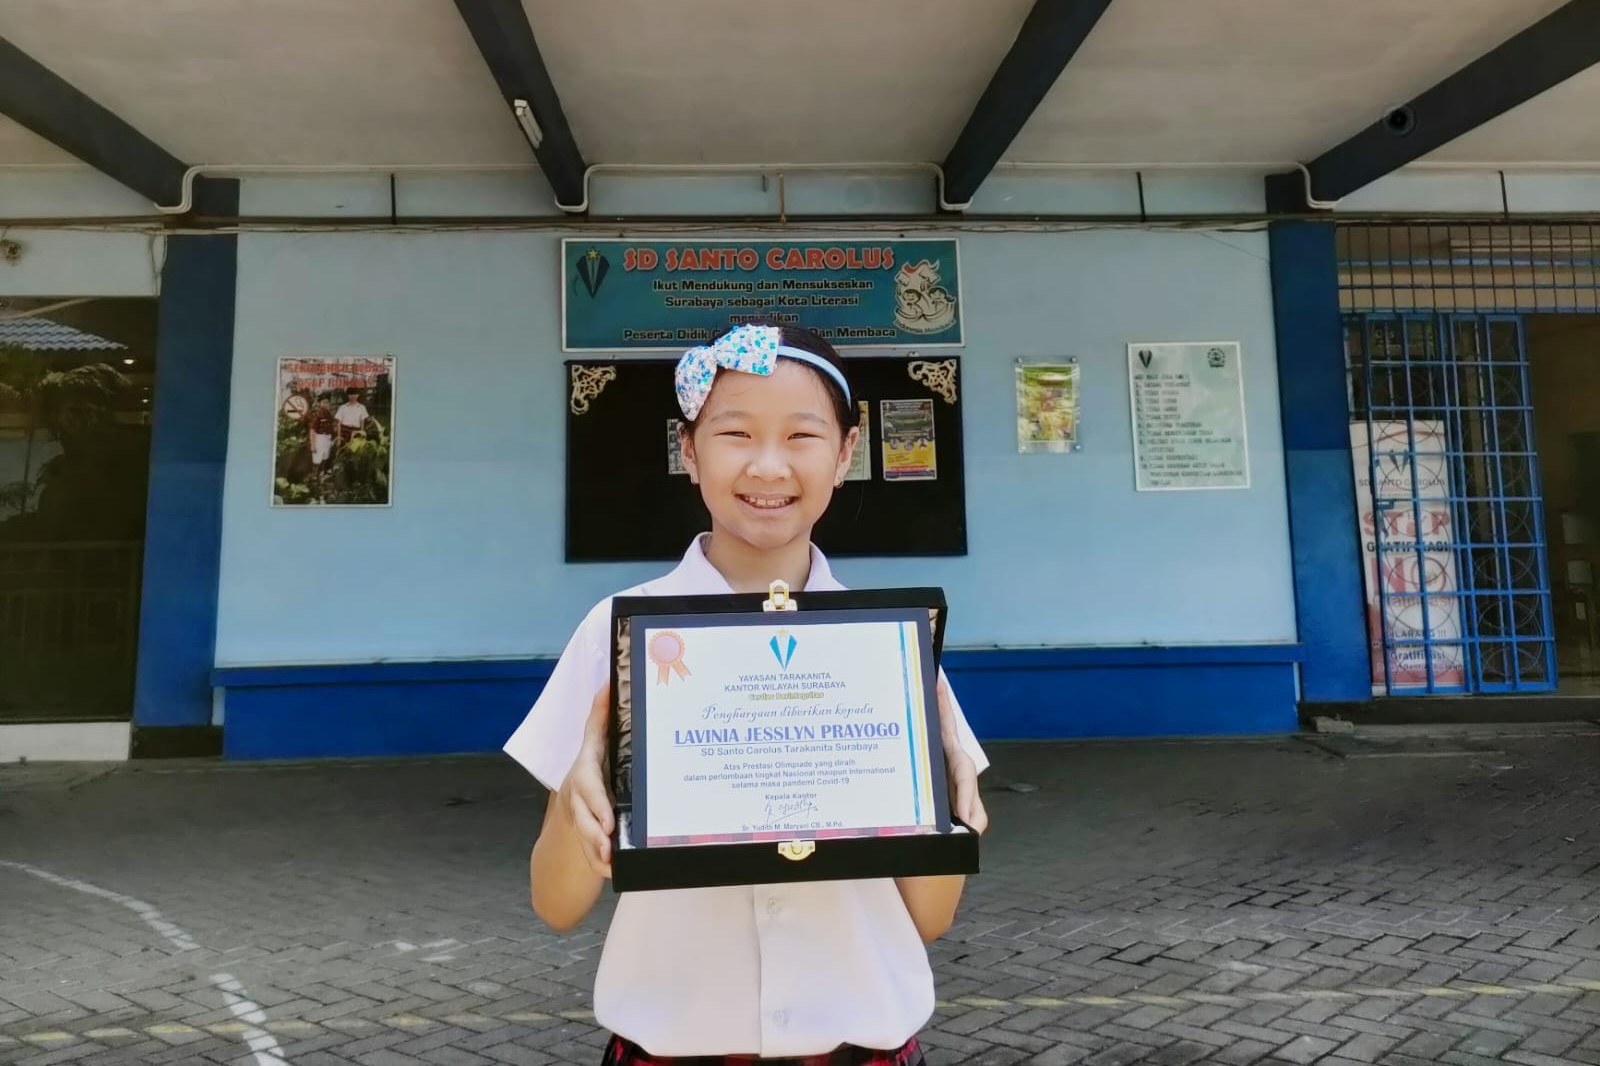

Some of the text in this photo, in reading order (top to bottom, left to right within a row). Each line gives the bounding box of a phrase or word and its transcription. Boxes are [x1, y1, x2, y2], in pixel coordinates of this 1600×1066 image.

[624, 247, 895, 271] SD SANTO CAROLUS
[653, 279, 873, 292] Ikut Mendukung dan Mensukseskan
[665, 296, 858, 309] Surabaya sebagai Kota Literasi
[624, 329, 673, 340] Peserta
[677, 329, 710, 340] Didik
[837, 327, 896, 338] Membaca
[1367, 541, 1449, 553] GATIFASI
[739, 672, 831, 682] YAYASAN TARAKANITA
[725, 681, 846, 692] KANTOR WILAYAH SURABAYA
[702, 702, 874, 723] Penghargaan diberikan kepada
[675, 722, 900, 744] LAVINIA JESSLYN PRAYOGO
[701, 743, 878, 756] SD Santo Carolus Tarakanita Surabaya
[775, 760, 812, 769] Olimpiade
[815, 760, 833, 769] yang
[755, 771, 780, 780] tingkat
[783, 779, 815, 788] pandemi
[817, 777, 850, 786] Covid-19
